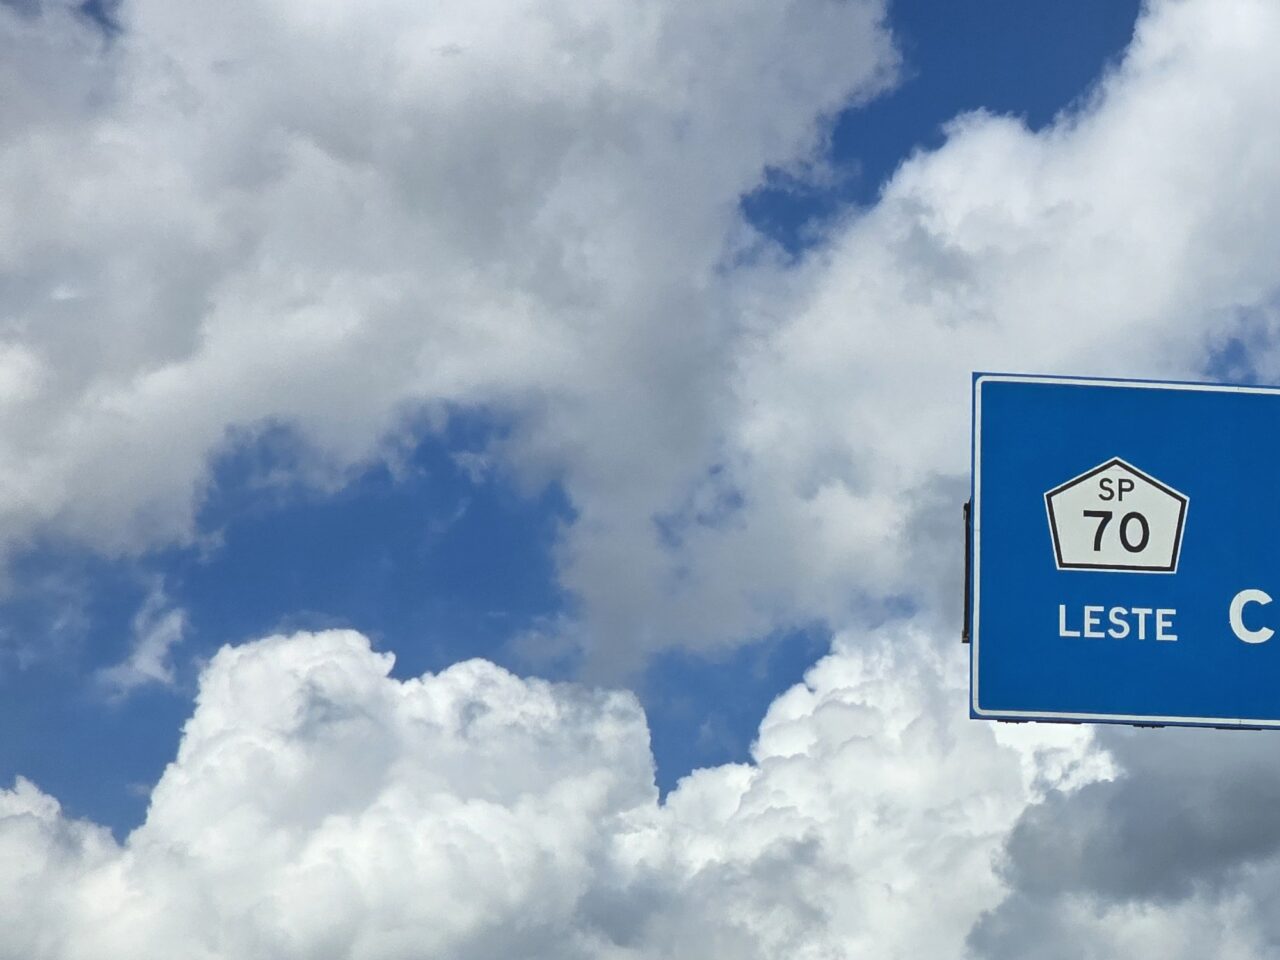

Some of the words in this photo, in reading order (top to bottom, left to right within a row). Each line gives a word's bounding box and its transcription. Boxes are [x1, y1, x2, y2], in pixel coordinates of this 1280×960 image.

[1098, 478, 1135, 502] SP
[1083, 510, 1150, 554] 70
[1058, 604, 1178, 642] LESTE
